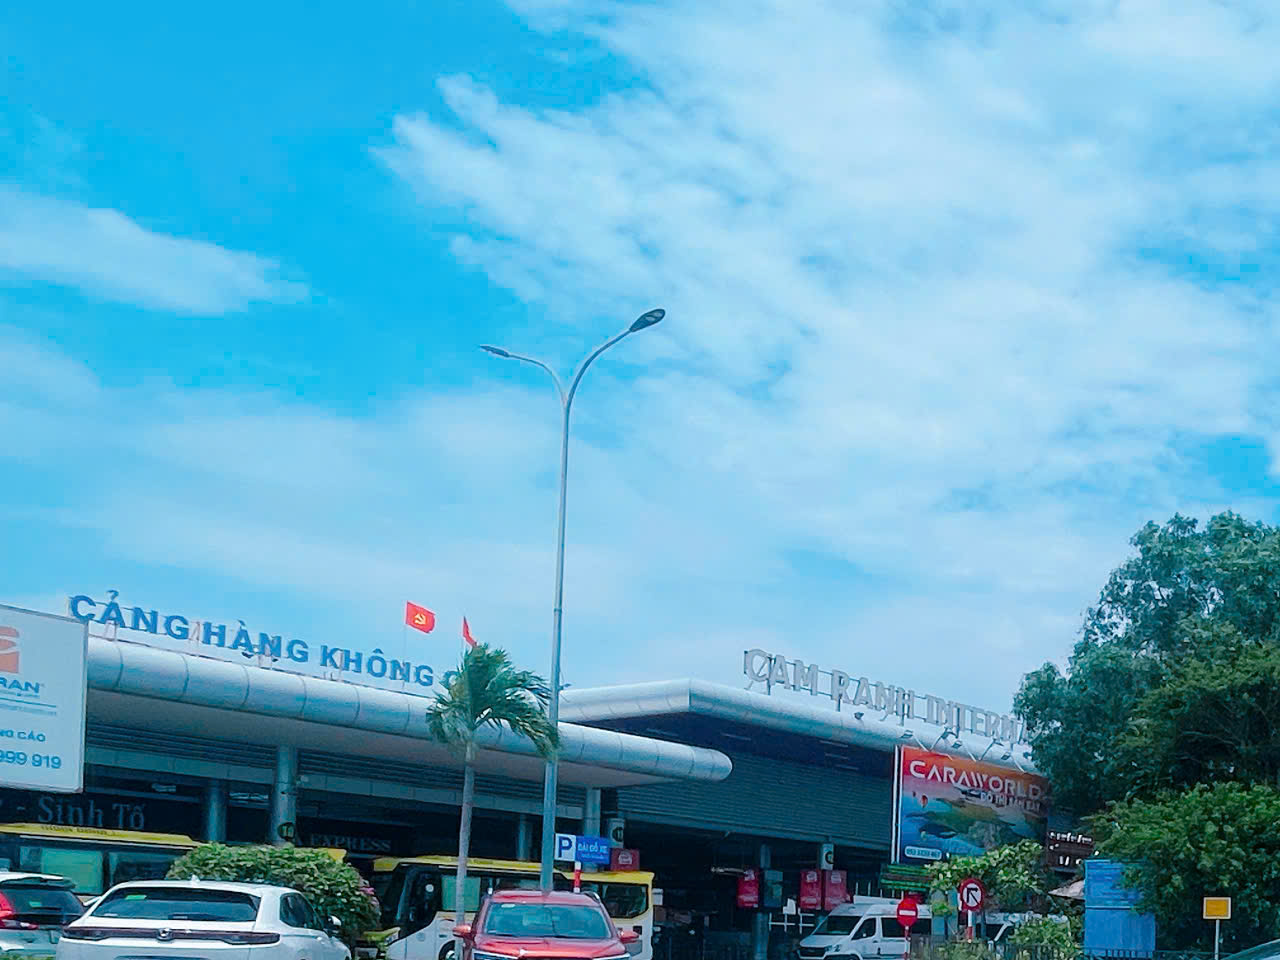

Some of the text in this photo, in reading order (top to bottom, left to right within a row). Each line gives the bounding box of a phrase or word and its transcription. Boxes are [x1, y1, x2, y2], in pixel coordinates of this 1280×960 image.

[70, 589, 190, 640] CẢNG
[202, 620, 309, 663] HÀNG
[320, 645, 434, 687] KHÔNG
[747, 649, 818, 696] CAM
[831, 669, 916, 720] RANH
[17, 730, 46, 742] CÁO
[32, 754, 62, 769] 919
[909, 760, 1042, 799] CARAWORLD
[38, 795, 104, 828] Sinh
[559, 837, 573, 858] P
